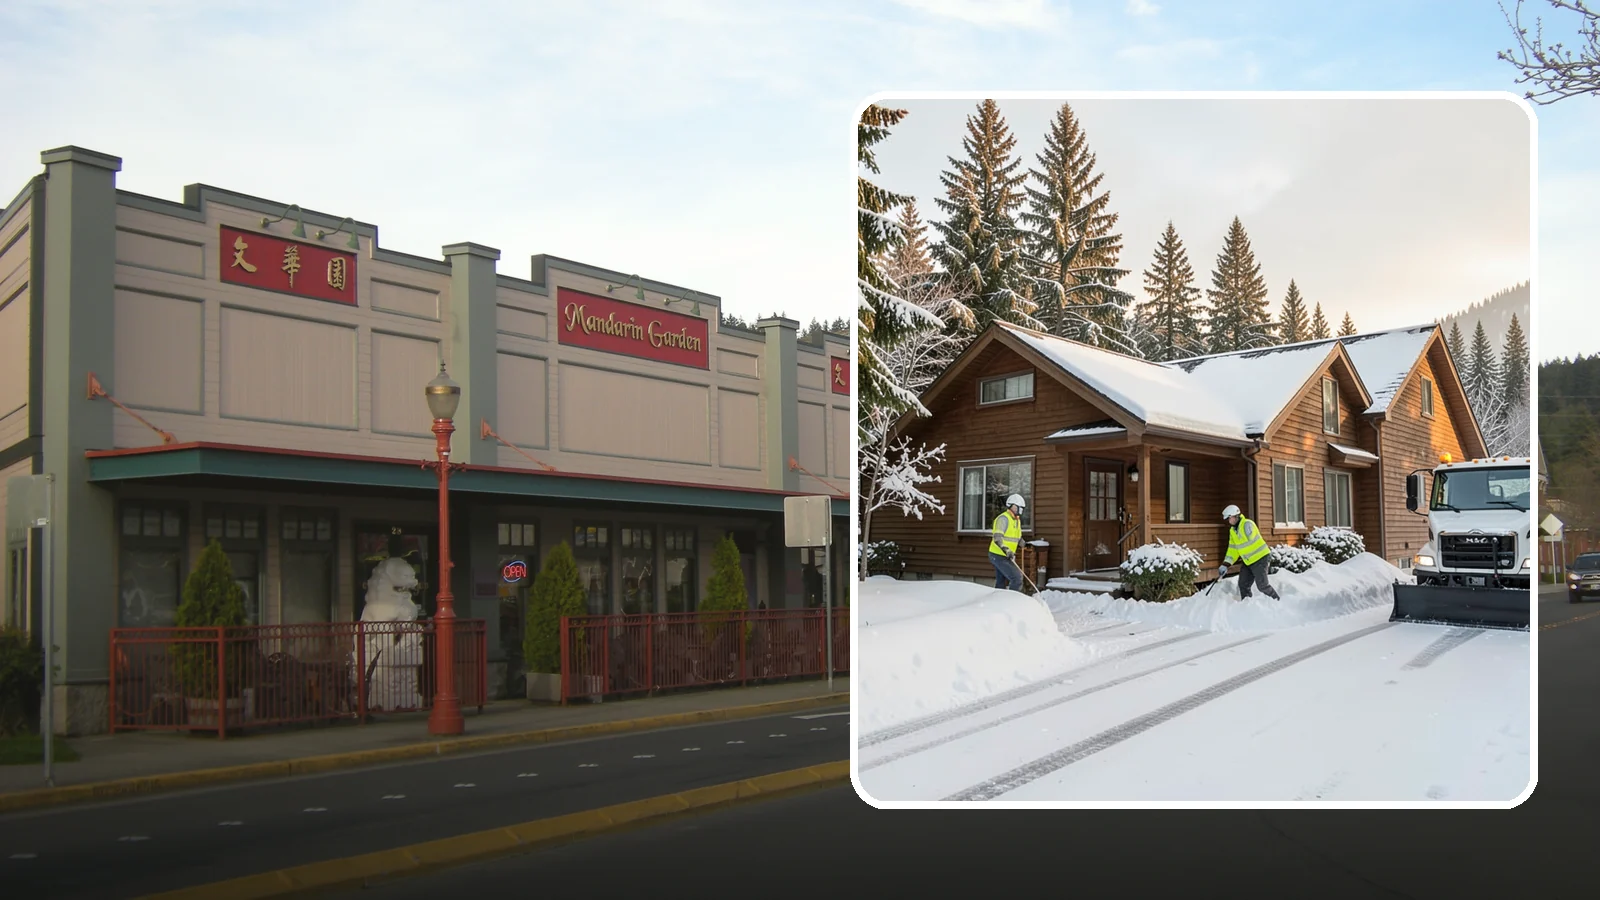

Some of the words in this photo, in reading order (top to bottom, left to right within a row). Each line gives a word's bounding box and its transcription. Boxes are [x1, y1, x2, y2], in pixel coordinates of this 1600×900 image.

[230, 235, 346, 291] 文華園
[564, 302, 644, 341] Mandarin
[648, 320, 702, 352] Garden
[503, 565, 527, 578] OPEN
